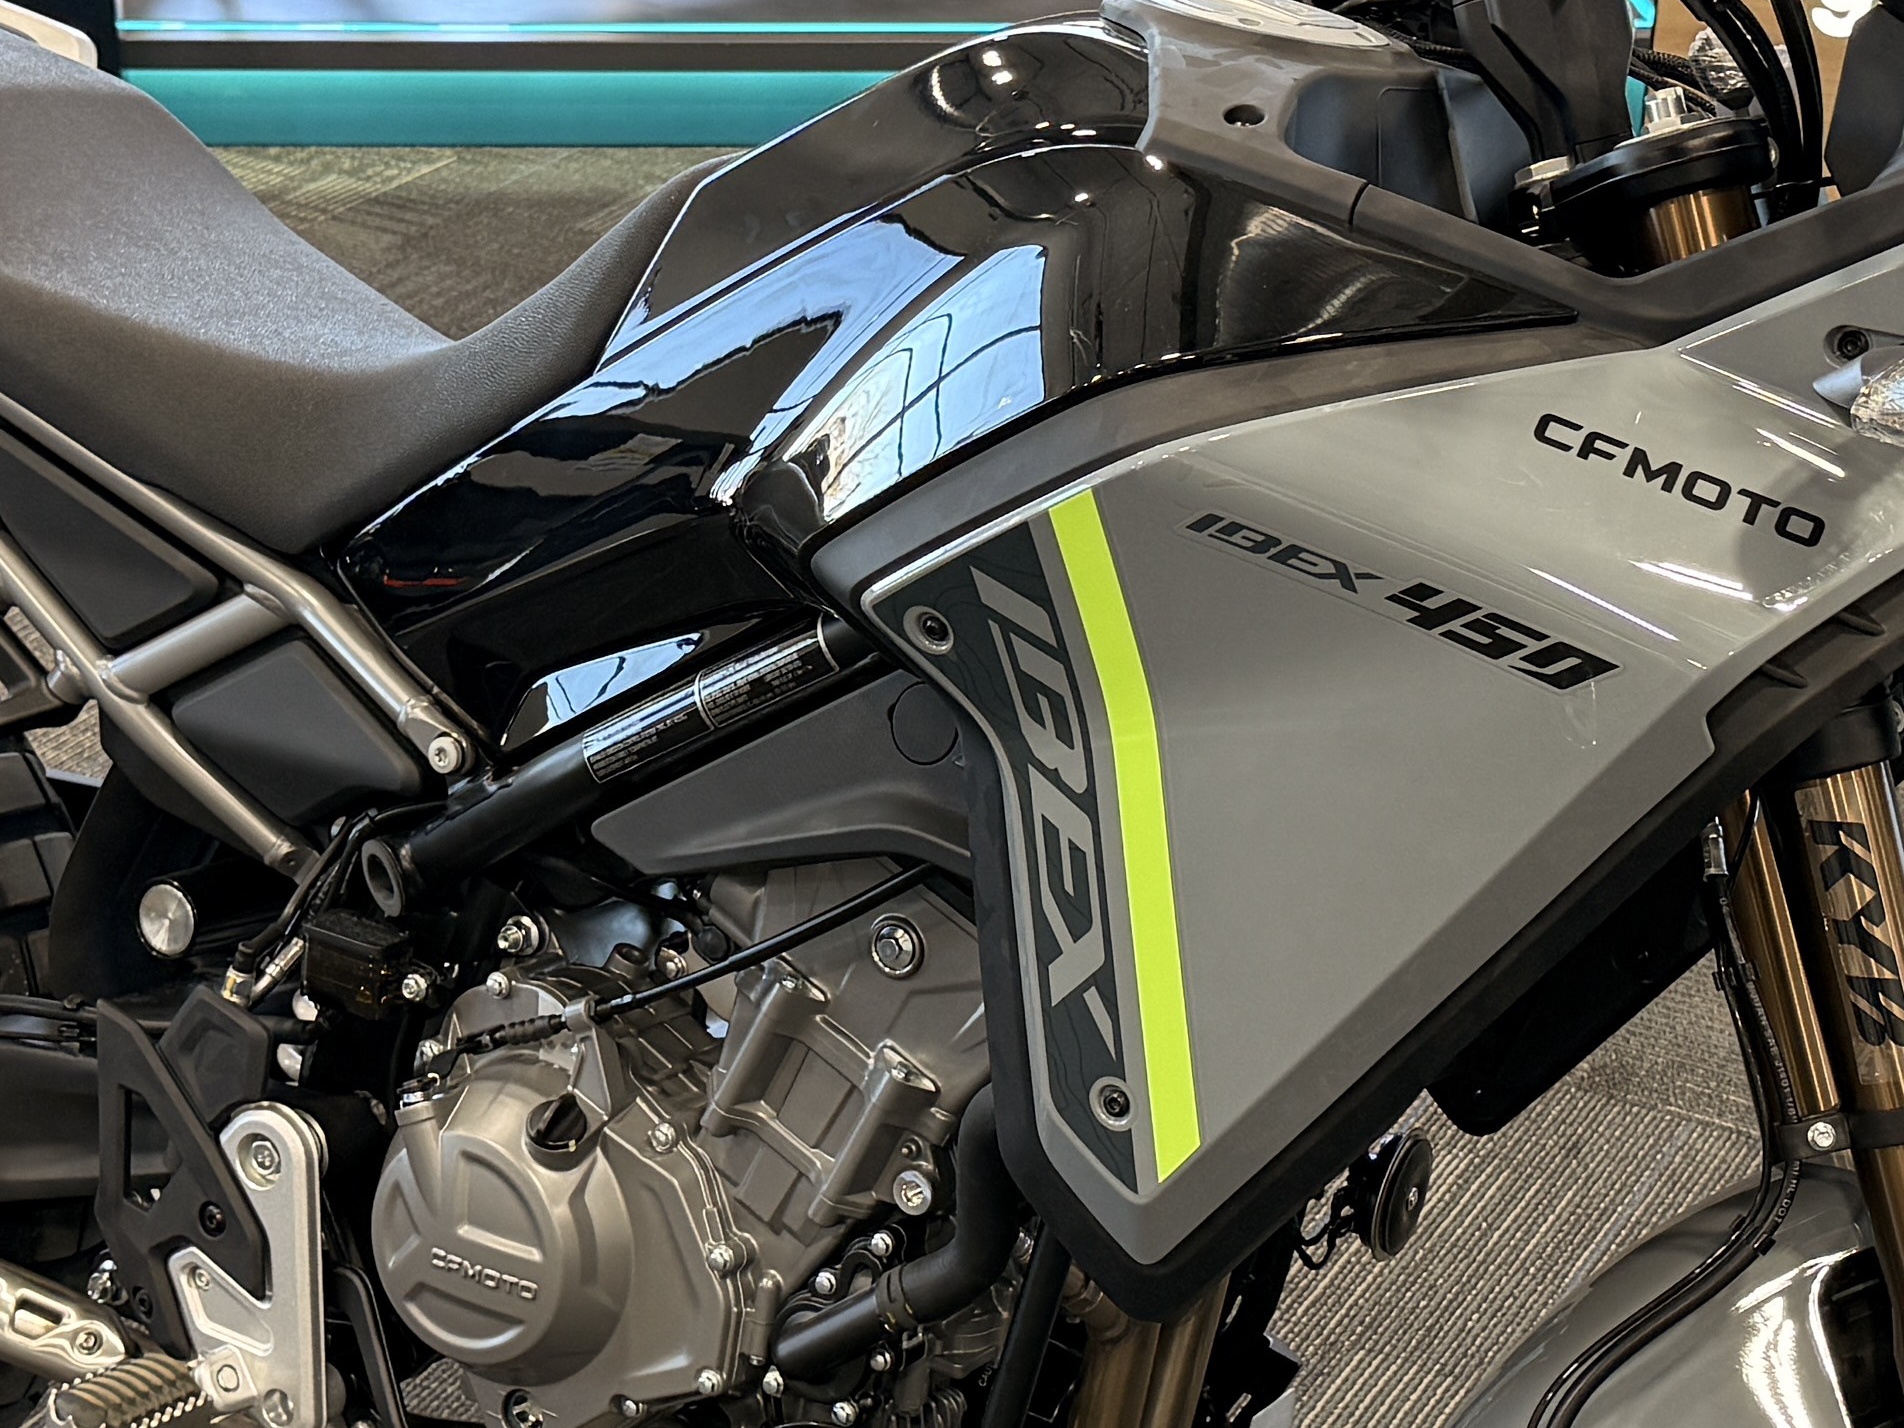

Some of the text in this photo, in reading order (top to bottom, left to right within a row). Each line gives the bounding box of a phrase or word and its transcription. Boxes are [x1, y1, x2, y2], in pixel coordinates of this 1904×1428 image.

[1532, 412, 1827, 549] CFMOTO
[1185, 512, 1621, 691] IBEX 450
[969, 566, 1116, 1054] IBEX
[431, 1246, 539, 1300] CFMOTO
